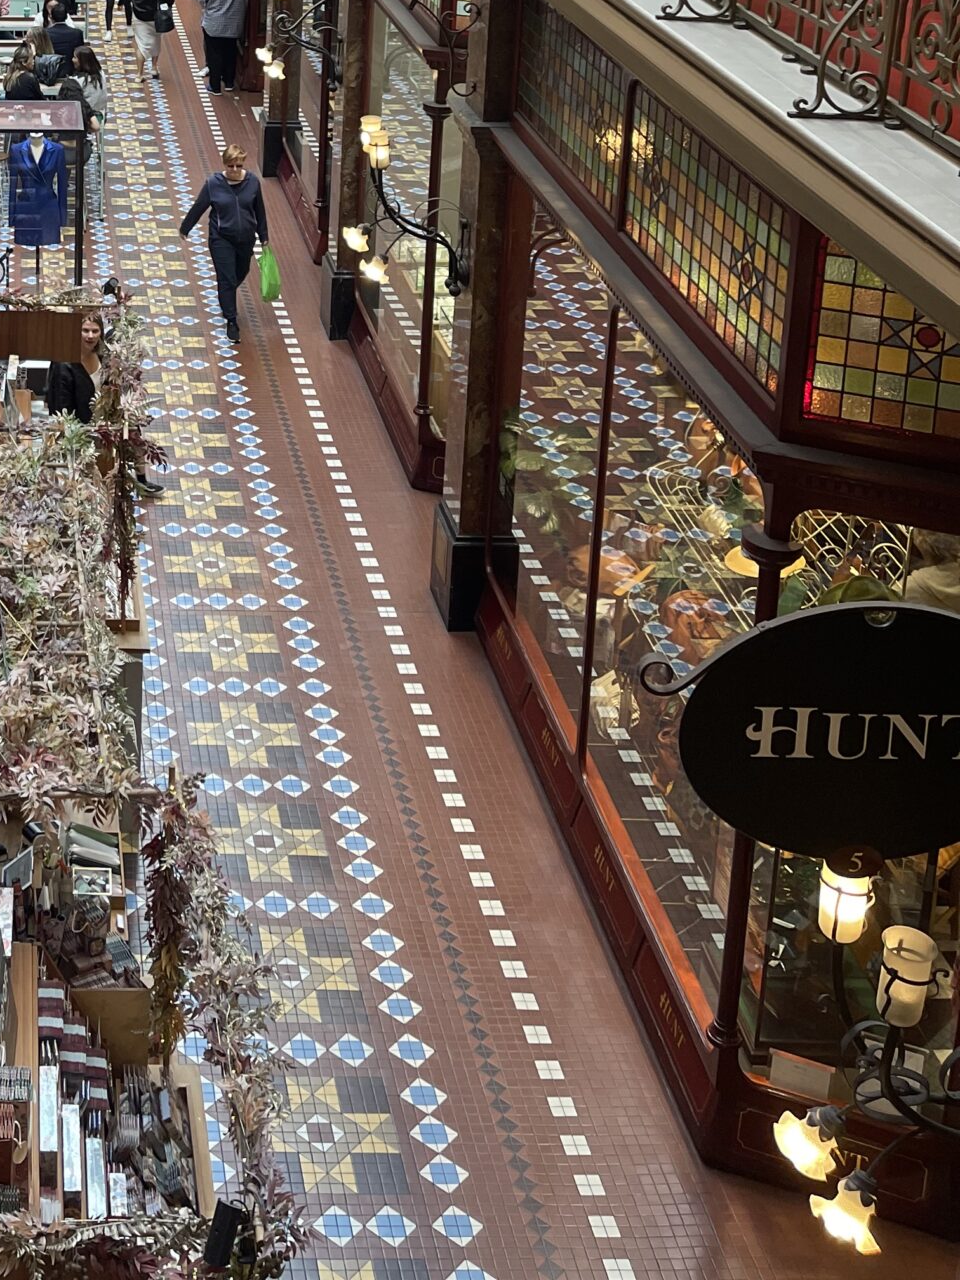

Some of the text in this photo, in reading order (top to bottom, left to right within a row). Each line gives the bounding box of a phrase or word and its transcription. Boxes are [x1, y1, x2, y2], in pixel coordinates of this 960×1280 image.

[593, 844, 616, 891] HUNT
[848, 852, 863, 872] 5
[660, 991, 685, 1048] HUNT
[830, 1146, 869, 1170] NT
